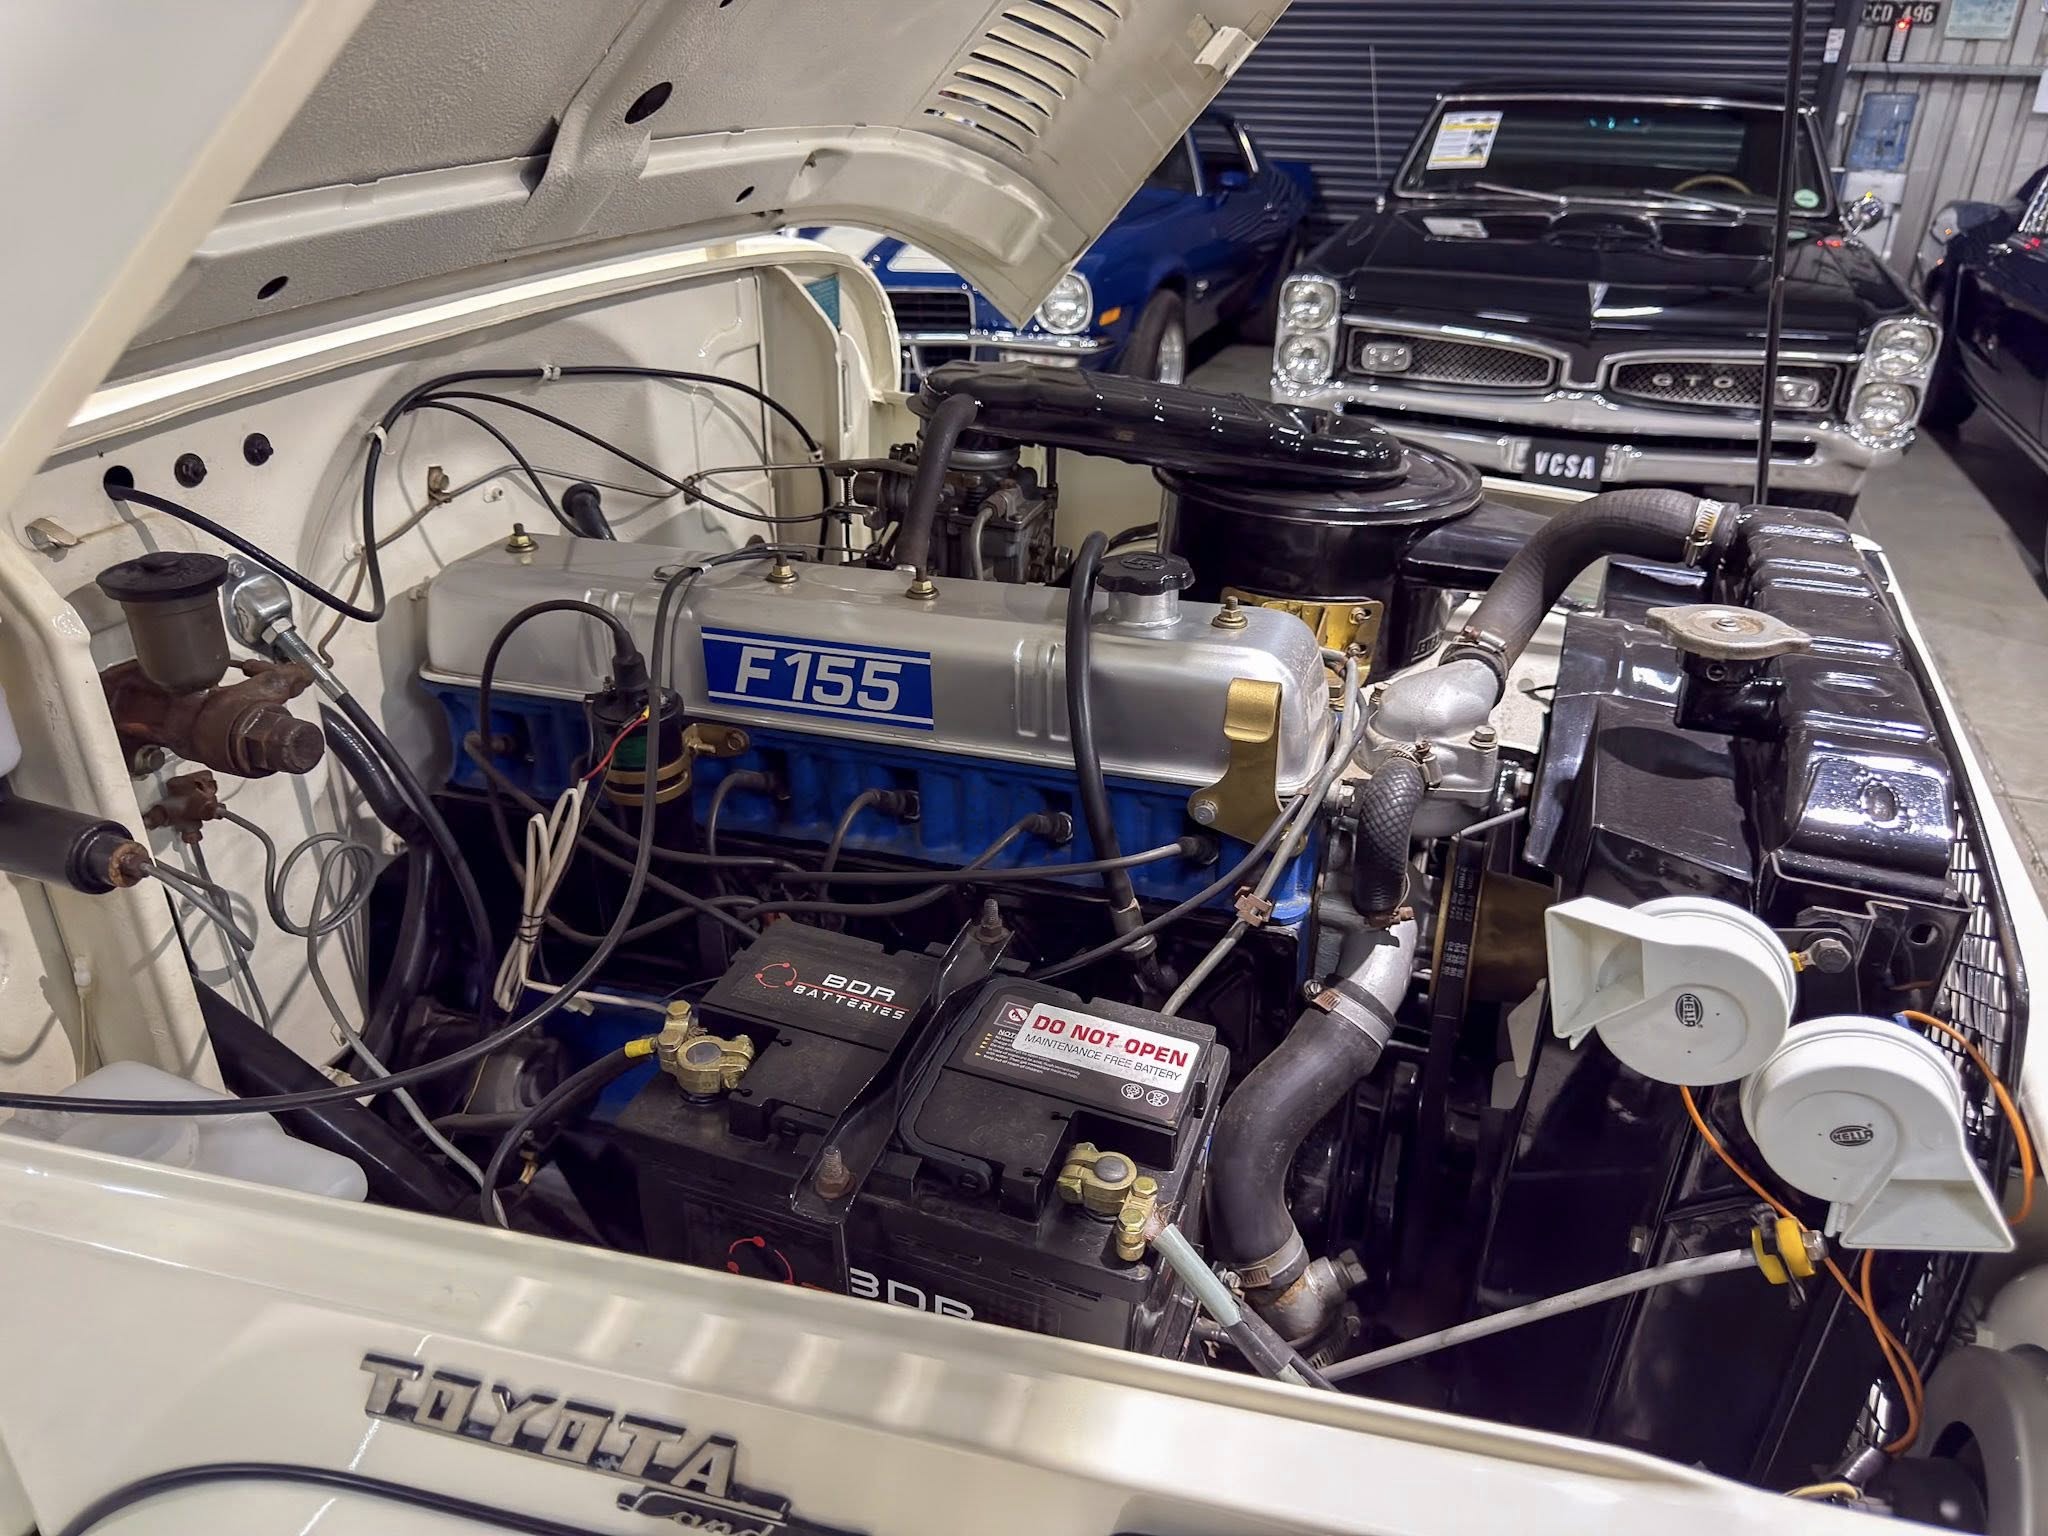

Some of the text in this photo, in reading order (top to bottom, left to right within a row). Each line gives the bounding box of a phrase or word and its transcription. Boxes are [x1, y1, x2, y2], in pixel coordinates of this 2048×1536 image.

[1652, 372, 1737, 389] GTO
[1533, 450, 1596, 481] VCSA
[792, 984, 907, 1022] BATTERIES
[821, 973, 897, 1003] BDR
[1024, 1033, 1102, 1061] MAINTENANCE
[1103, 1054, 1133, 1069] FREE
[1134, 1062, 1183, 1081] BATTERY
[1032, 1015, 1188, 1068] DO NOT OPEN
[360, 1351, 738, 1498] TOYOTA
